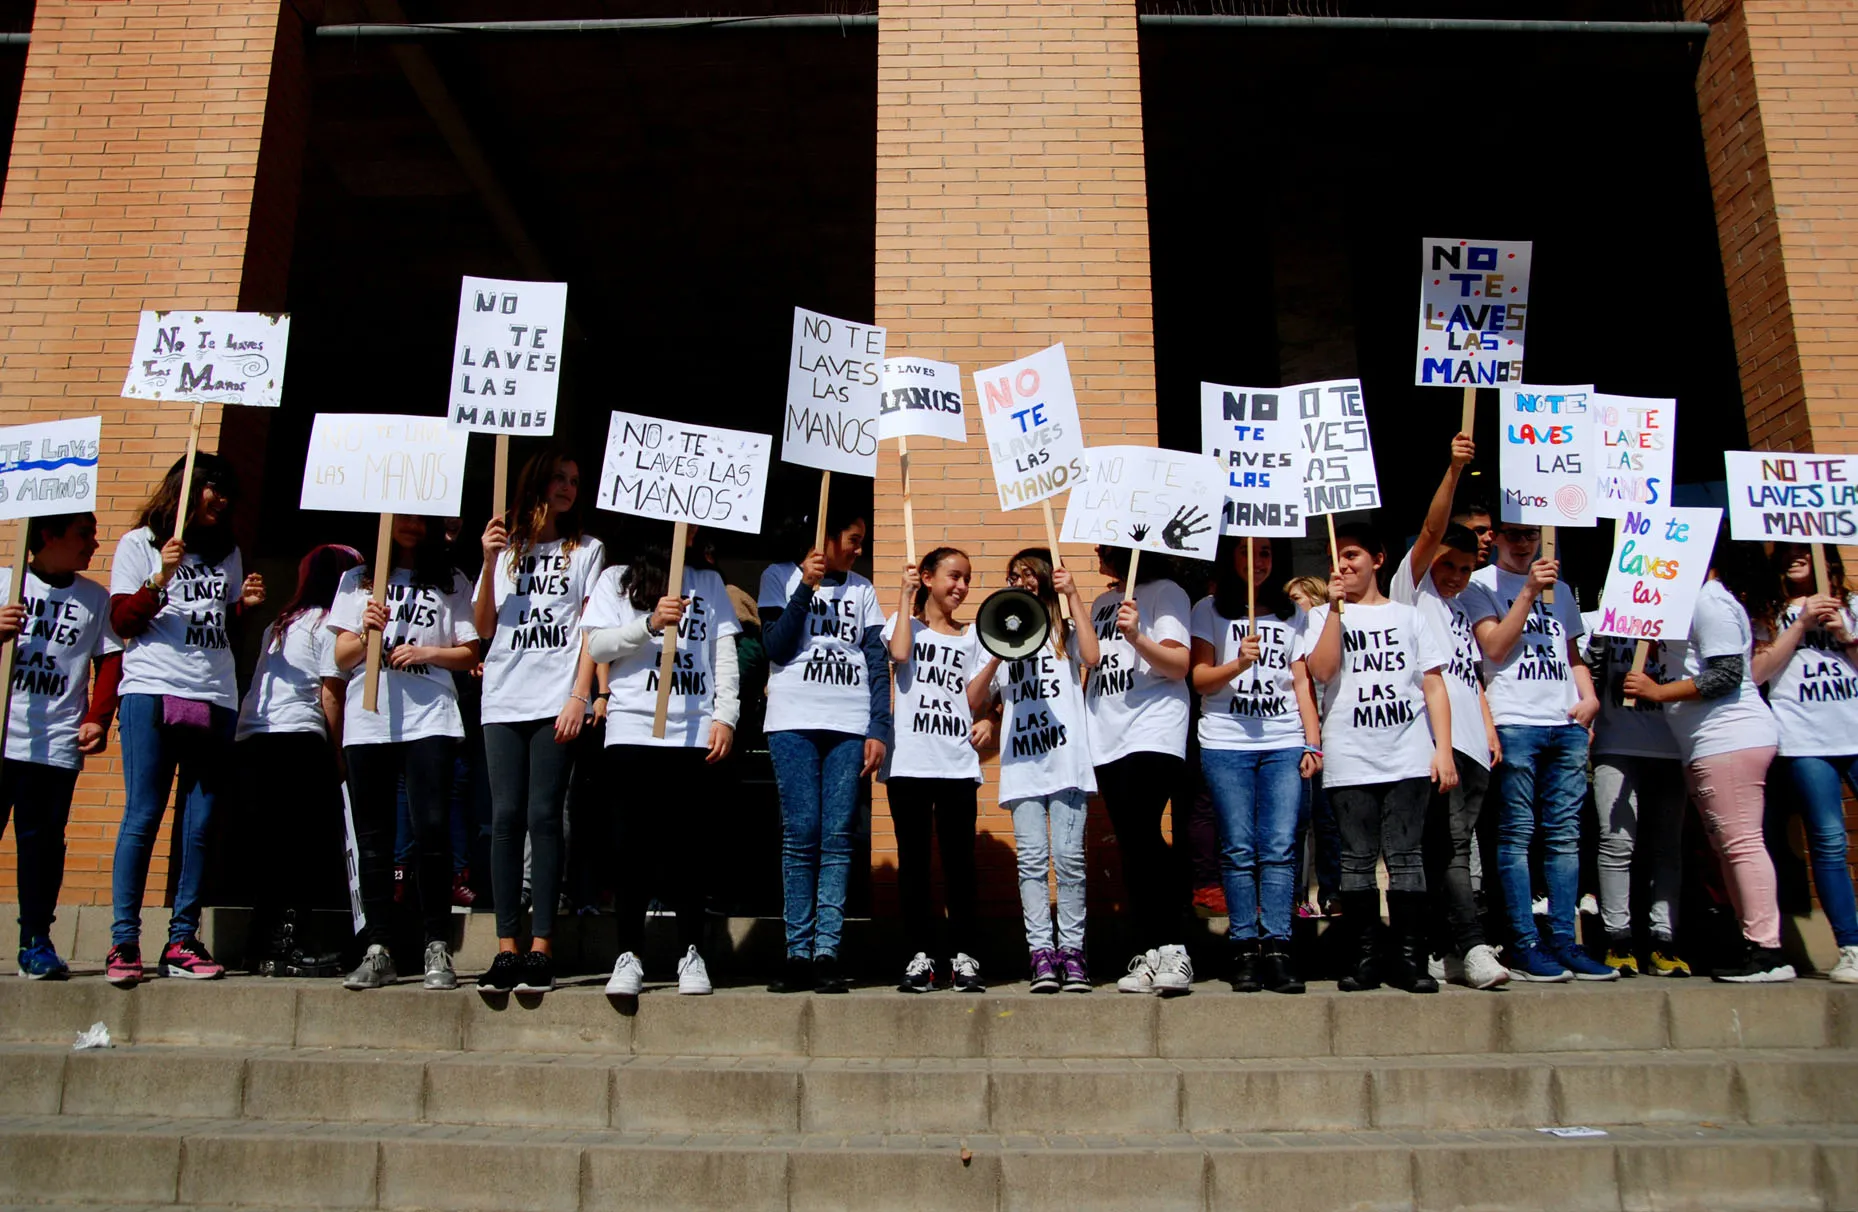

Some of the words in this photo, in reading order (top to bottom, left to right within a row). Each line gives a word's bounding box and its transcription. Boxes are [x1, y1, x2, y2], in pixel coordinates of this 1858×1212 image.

[1432, 246, 1498, 270] NO
[1449, 273, 1504, 298] TE
[473, 290, 518, 314] NO
[1425, 303, 1526, 332] LAVES
[153, 327, 185, 353] No
[509, 324, 547, 348] TE
[804, 316, 831, 343] NO
[845, 326, 881, 354] TE
[1448, 331, 1499, 350] LAS
[461, 345, 556, 372] LAVES
[799, 346, 879, 386] LAVES
[884, 364, 891, 373] E
[898, 365, 935, 377] LAVES
[1422, 358, 1521, 384] MANOS
[461, 373, 516, 396] LAS
[813, 377, 849, 402] LAS
[984, 368, 1041, 415] NO
[1223, 391, 1279, 421] NO
[1300, 387, 1321, 419] O
[1328, 385, 1364, 417] TE
[453, 404, 547, 428] MANOS
[1011, 403, 1048, 433] TE
[1593, 406, 1618, 427] NO
[1627, 408, 1660, 429] TE
[320, 422, 363, 452] NO
[623, 421, 662, 449] NO
[680, 431, 707, 456] TE
[786, 404, 877, 456] MANOS
[1234, 425, 1264, 441] TE
[1301, 420, 1369, 453] VES
[1508, 424, 1573, 444] LAVES
[1604, 430, 1664, 450] LAVES
[0, 441, 32, 468] TE
[992, 423, 1063, 464] LAVES
[636, 451, 699, 478] LAVES
[709, 461, 751, 487] LAS
[1015, 448, 1050, 473] LAS
[1213, 448, 1292, 468] AVES
[1303, 456, 1350, 483] AS
[1536, 454, 1582, 473] LAS
[1607, 451, 1644, 471] LAS
[316, 465, 345, 485] LAS
[363, 451, 448, 501] MANOS
[1000, 457, 1083, 506] MANOS
[1097, 457, 1124, 484] NO
[1146, 459, 1186, 488] TE
[1229, 472, 1270, 488] LAS
[1762, 460, 1797, 482] NO
[1805, 460, 1847, 482] TE
[16, 473, 90, 500] MANOS
[611, 474, 732, 520] MANOS
[1304, 483, 1377, 513] ANOS
[1506, 488, 1549, 507] Manos
[1597, 476, 1661, 505] MANOS
[1747, 484, 1824, 508] LAVES
[1073, 518, 1119, 541] LAS
[1622, 511, 1651, 535] No
[1665, 517, 1689, 542] te
[1763, 510, 1857, 537] MANOS
[515, 556, 536, 573] NO
[540, 555, 565, 573] TE
[1618, 540, 1679, 580] laves
[408, 584, 437, 602] TE
[516, 575, 570, 596] LAVES
[1633, 581, 1662, 605] las
[22, 596, 46, 617] NO
[50, 600, 79, 621] TE
[191, 611, 222, 627] LAS
[387, 603, 437, 627] AVES
[520, 607, 554, 625] LAS
[809, 596, 827, 616] NO
[829, 598, 855, 618] TE
[20, 619, 80, 646] LAVES
[810, 620, 858, 644] LAVES
[1095, 620, 1123, 641] AVE
[1522, 618, 1560, 636] AVES
[1600, 607, 1664, 637] Manos
[185, 627, 229, 650] MAN
[511, 625, 568, 650] MANOS
[1232, 624, 1250, 641] N
[1258, 626, 1284, 645] TE
[1343, 630, 1366, 652] NO
[1369, 628, 1399, 649] TE
[16, 650, 56, 670] LAS
[812, 648, 847, 662] LAS
[913, 642, 936, 661] NO
[940, 646, 965, 669] TE
[1238, 647, 1286, 670] VES
[1353, 651, 1405, 673] LAVES
[1523, 644, 1556, 658] LAS
[803, 662, 861, 686] MANOS
[916, 666, 965, 695] LAVES
[1008, 659, 1026, 684] NO
[1031, 655, 1055, 675] TE
[1517, 660, 1567, 681] MANOS
[1803, 662, 1842, 678] LAS
[1013, 679, 1060, 705] LAVES
[1238, 680, 1274, 695] LAS
[1359, 684, 1396, 702] LAS
[1800, 677, 1858, 702] MANOS
[919, 694, 952, 714] LAS
[1229, 696, 1288, 717] MANOS
[1353, 700, 1414, 728] MANOS
[913, 712, 967, 737] MANOS
[1016, 710, 1049, 732] LAS
[1012, 724, 1068, 758] MANOS
[394, 870, 403, 880] 23
